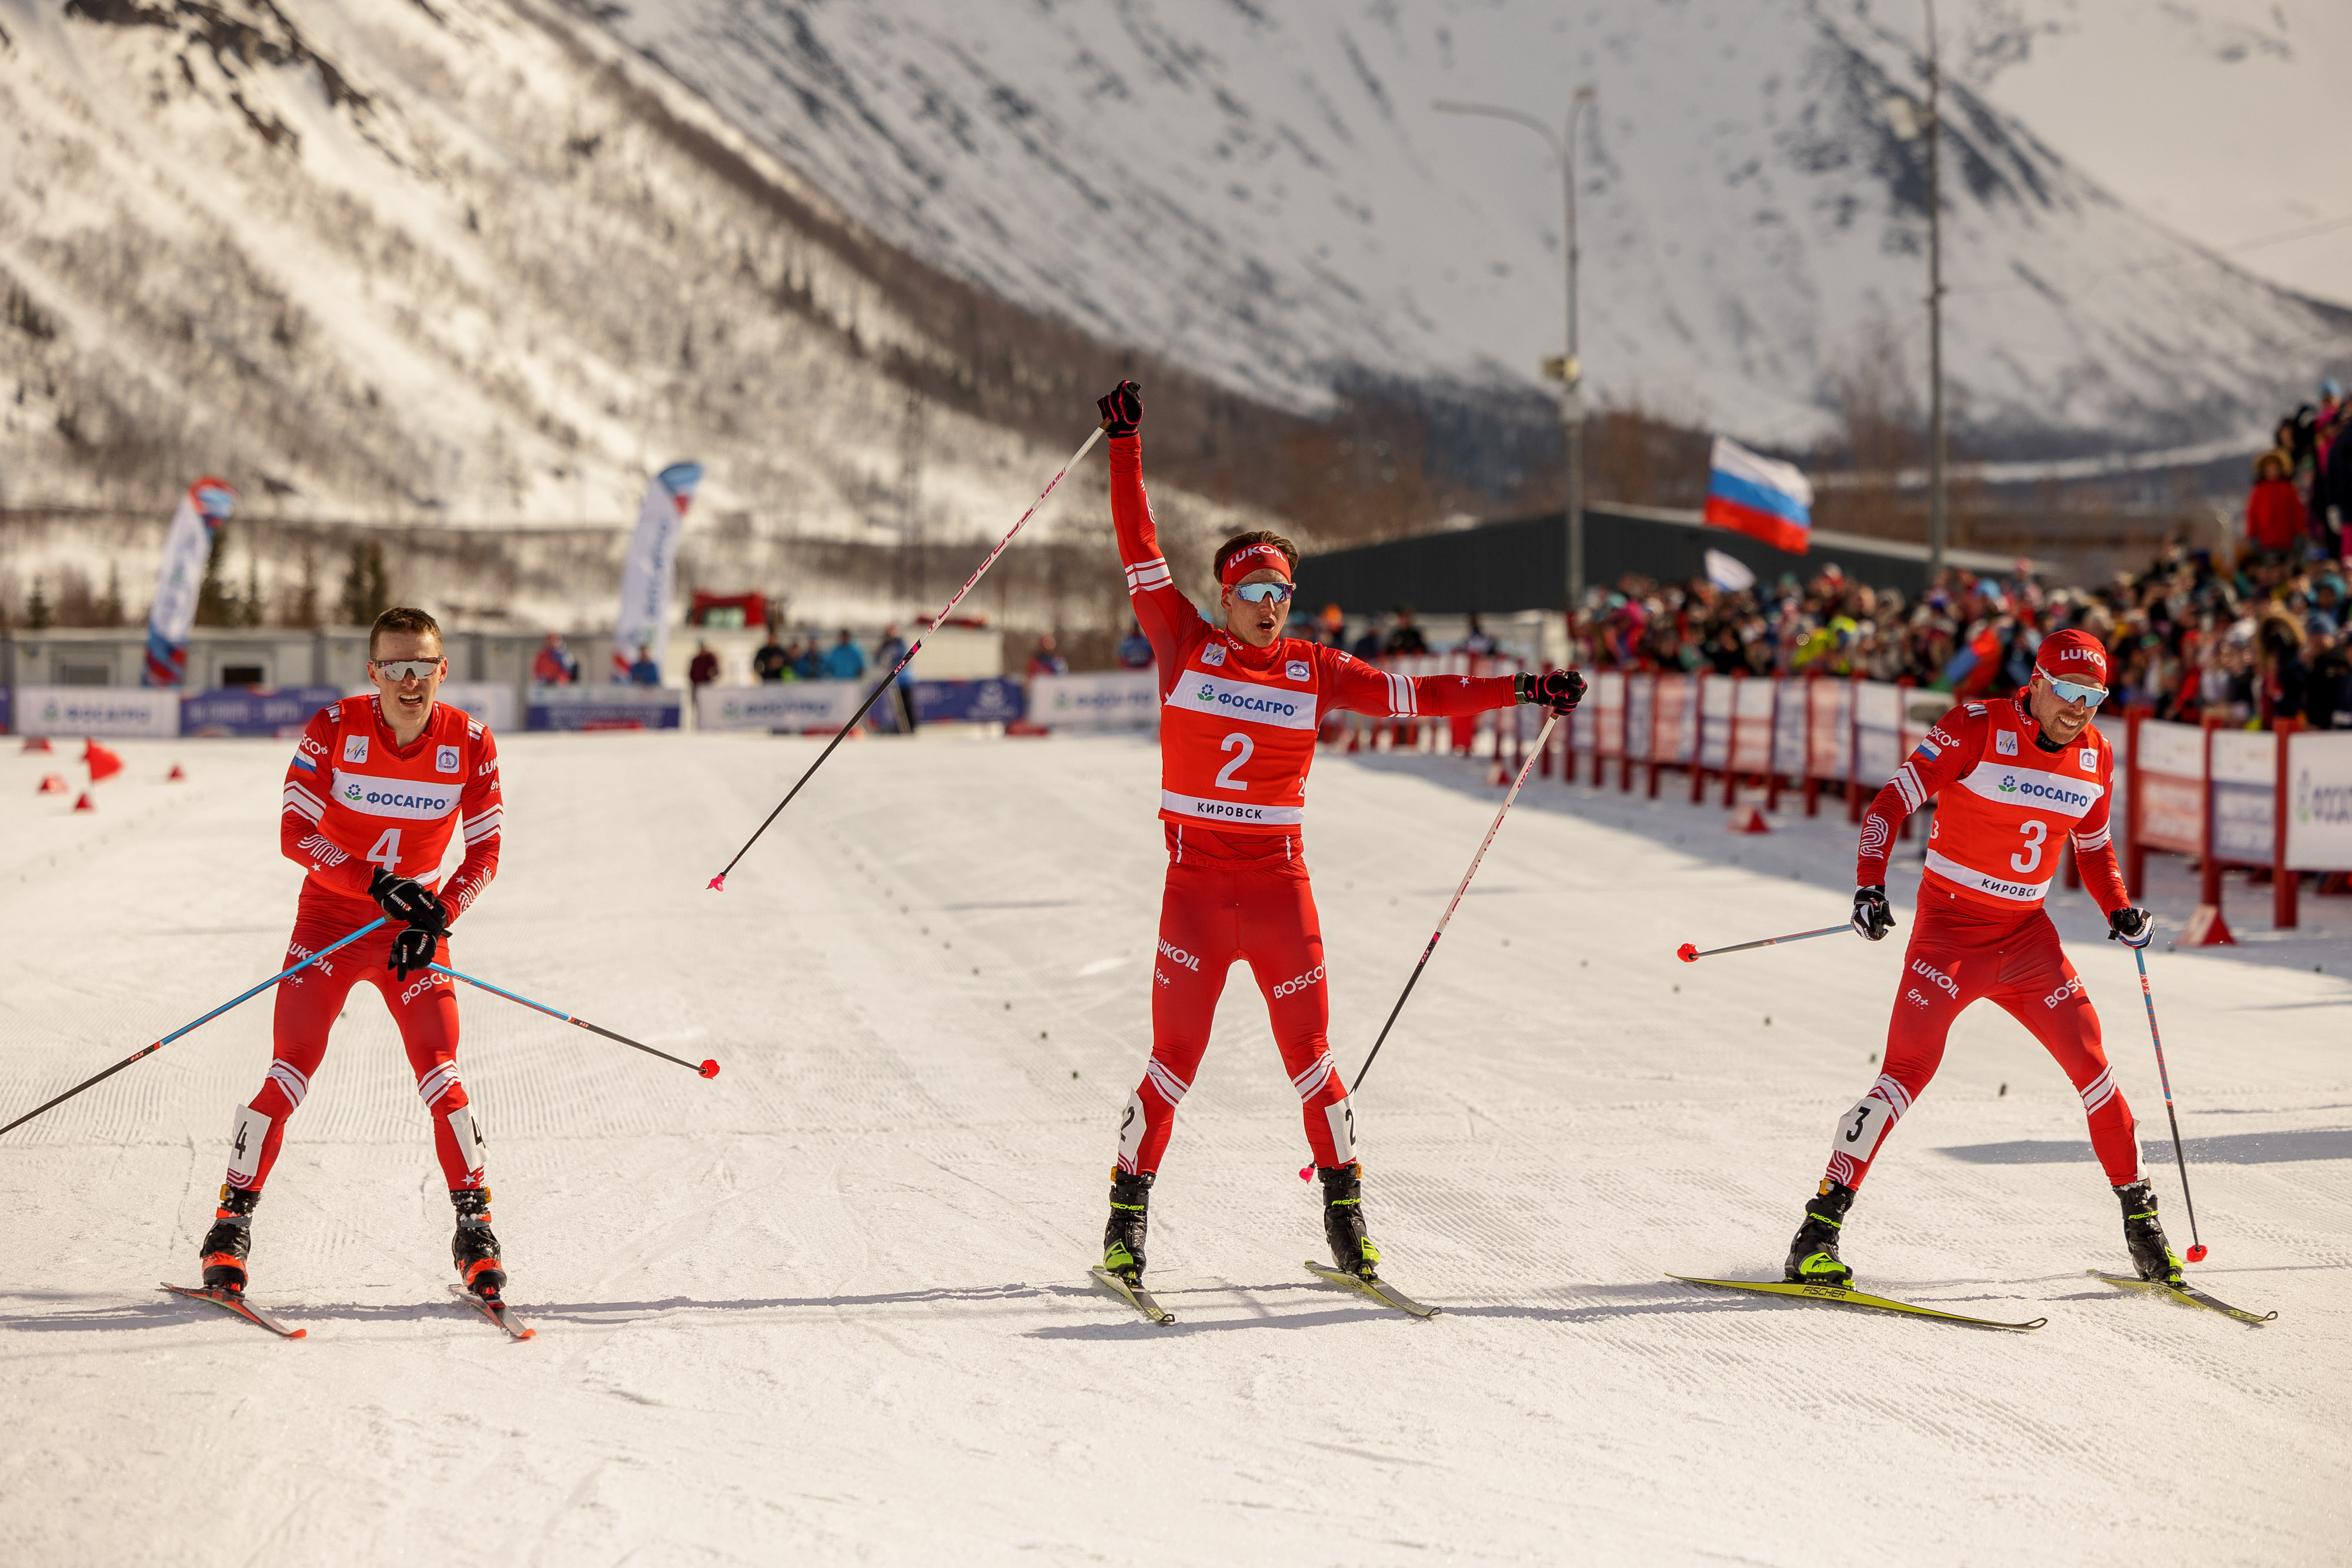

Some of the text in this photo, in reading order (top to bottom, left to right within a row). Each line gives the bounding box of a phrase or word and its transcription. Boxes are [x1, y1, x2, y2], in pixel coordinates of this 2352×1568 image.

[1230, 545, 1287, 569] LUKOIL
[1206, 653, 1222, 661] FIS
[1218, 693, 1295, 716] ФОСАГРО
[1215, 733, 1254, 791] 2
[1298, 777, 1305, 797] 2
[2020, 783, 2087, 807] ФОСАГРО
[366, 792, 446, 810] ФОСАГРО
[1197, 803, 1262, 819] КИРОВСК
[1930, 820, 1939, 839] 3
[366, 828, 402, 872] 4
[2010, 820, 2047, 873] 3
[1982, 878, 2038, 897] КИРОВСК
[1273, 966, 1324, 999] BOSCO
[1911, 959, 1960, 999] LUKOIL
[1121, 1106, 1135, 1142] 2
[1345, 1109, 1356, 1146] 2
[1846, 1106, 1871, 1142] 3
[235, 1121, 248, 1159] 4
[1802, 1286, 1846, 1299] FISCHER
